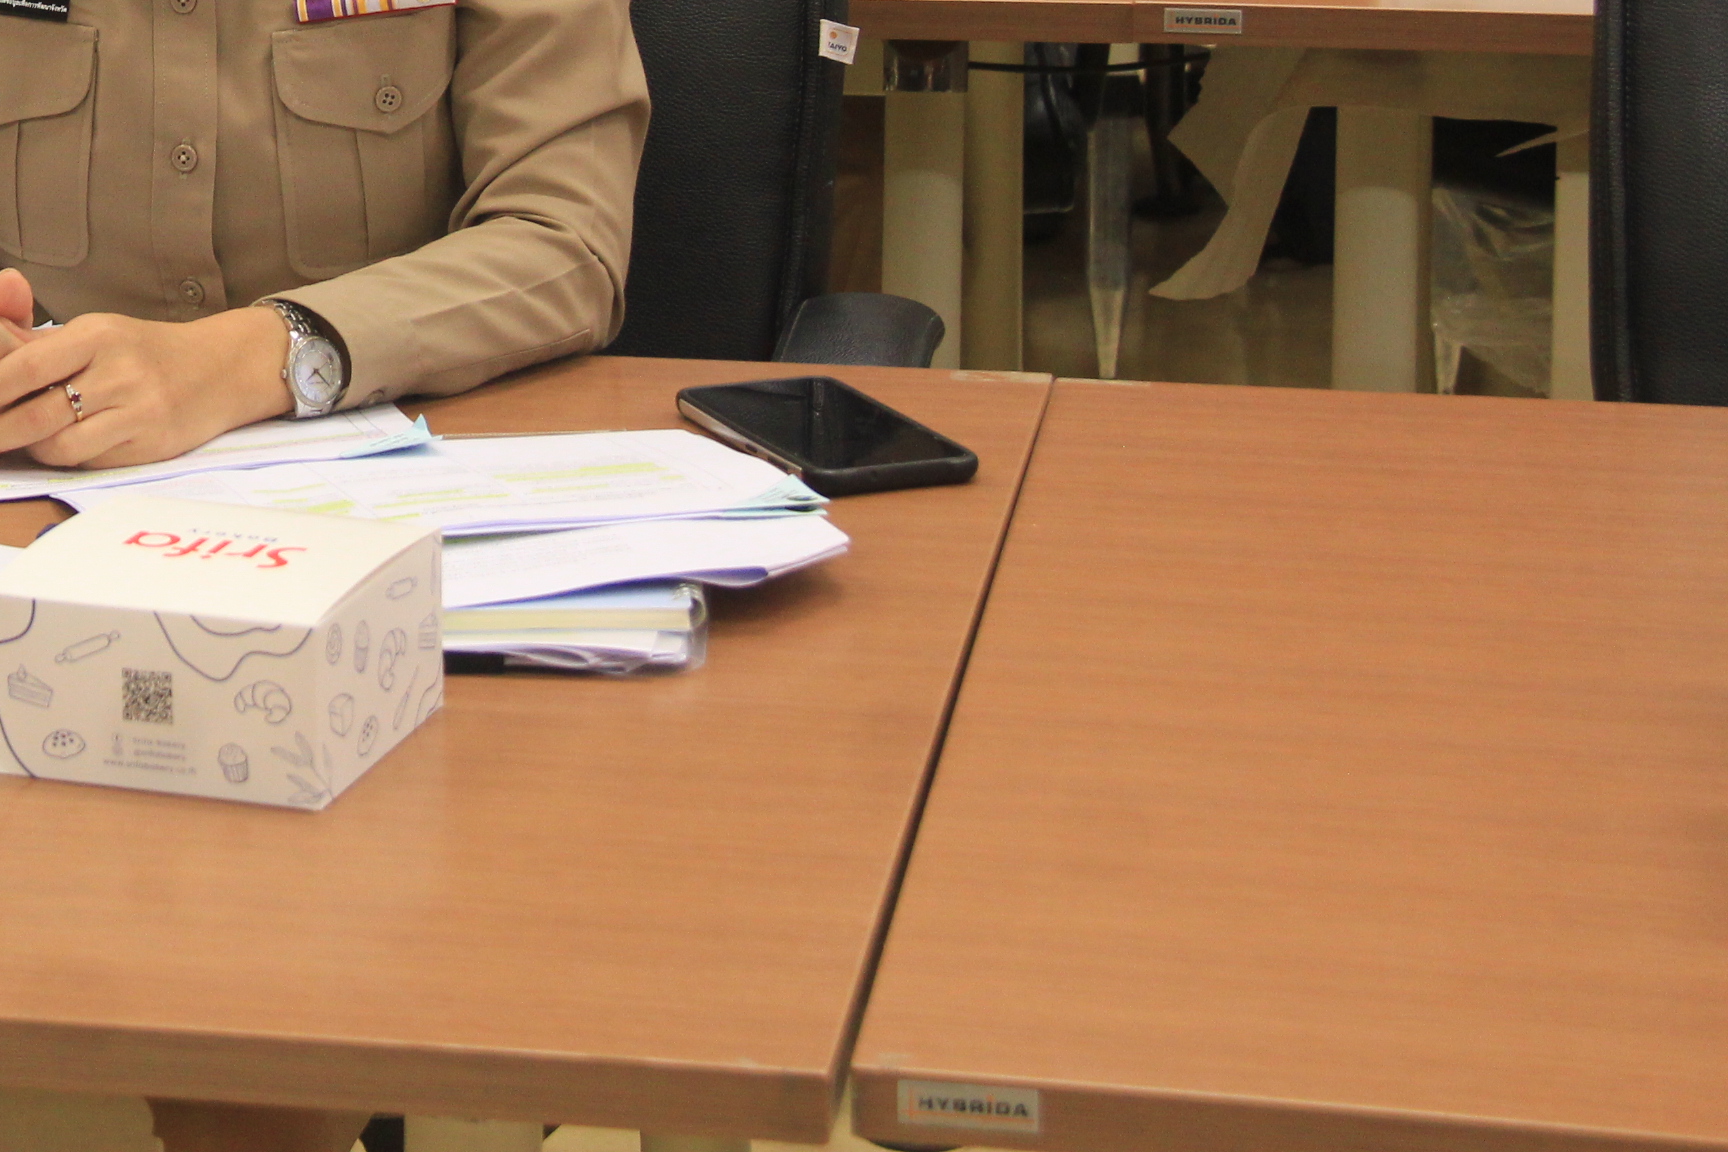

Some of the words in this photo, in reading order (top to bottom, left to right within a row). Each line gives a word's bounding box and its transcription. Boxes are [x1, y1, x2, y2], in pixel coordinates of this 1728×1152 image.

[1175, 13, 1237, 26] HYBRIDA
[122, 530, 308, 569] Srifa
[918, 1094, 1029, 1117] HYBRIDA
